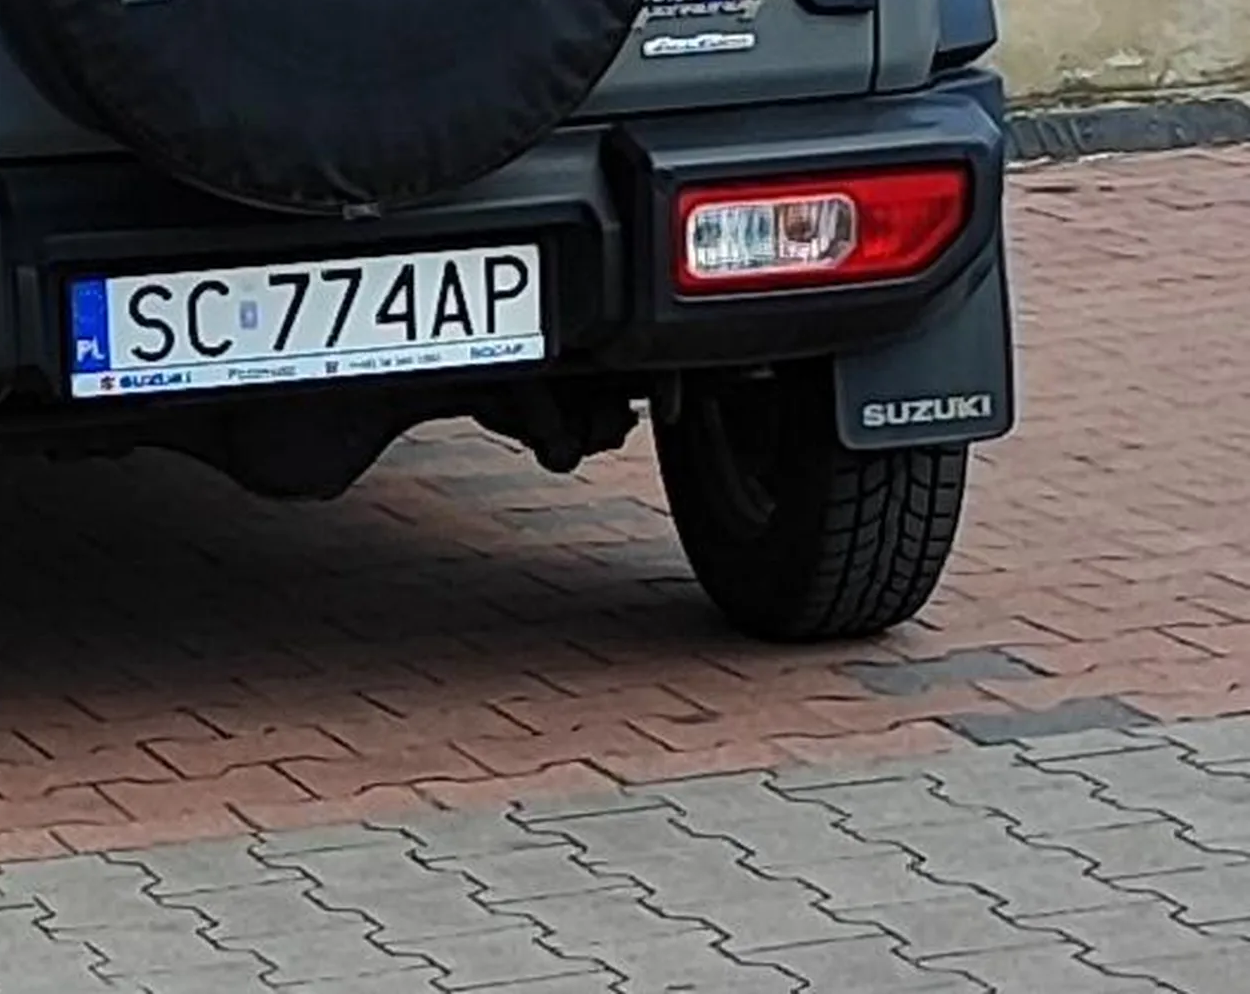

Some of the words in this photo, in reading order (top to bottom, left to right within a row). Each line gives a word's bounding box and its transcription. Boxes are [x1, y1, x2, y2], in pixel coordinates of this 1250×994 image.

[128, 280, 233, 362] SC
[268, 254, 530, 351] 774AP
[76, 335, 105, 362] PL
[862, 394, 991, 427] SUZUKI
